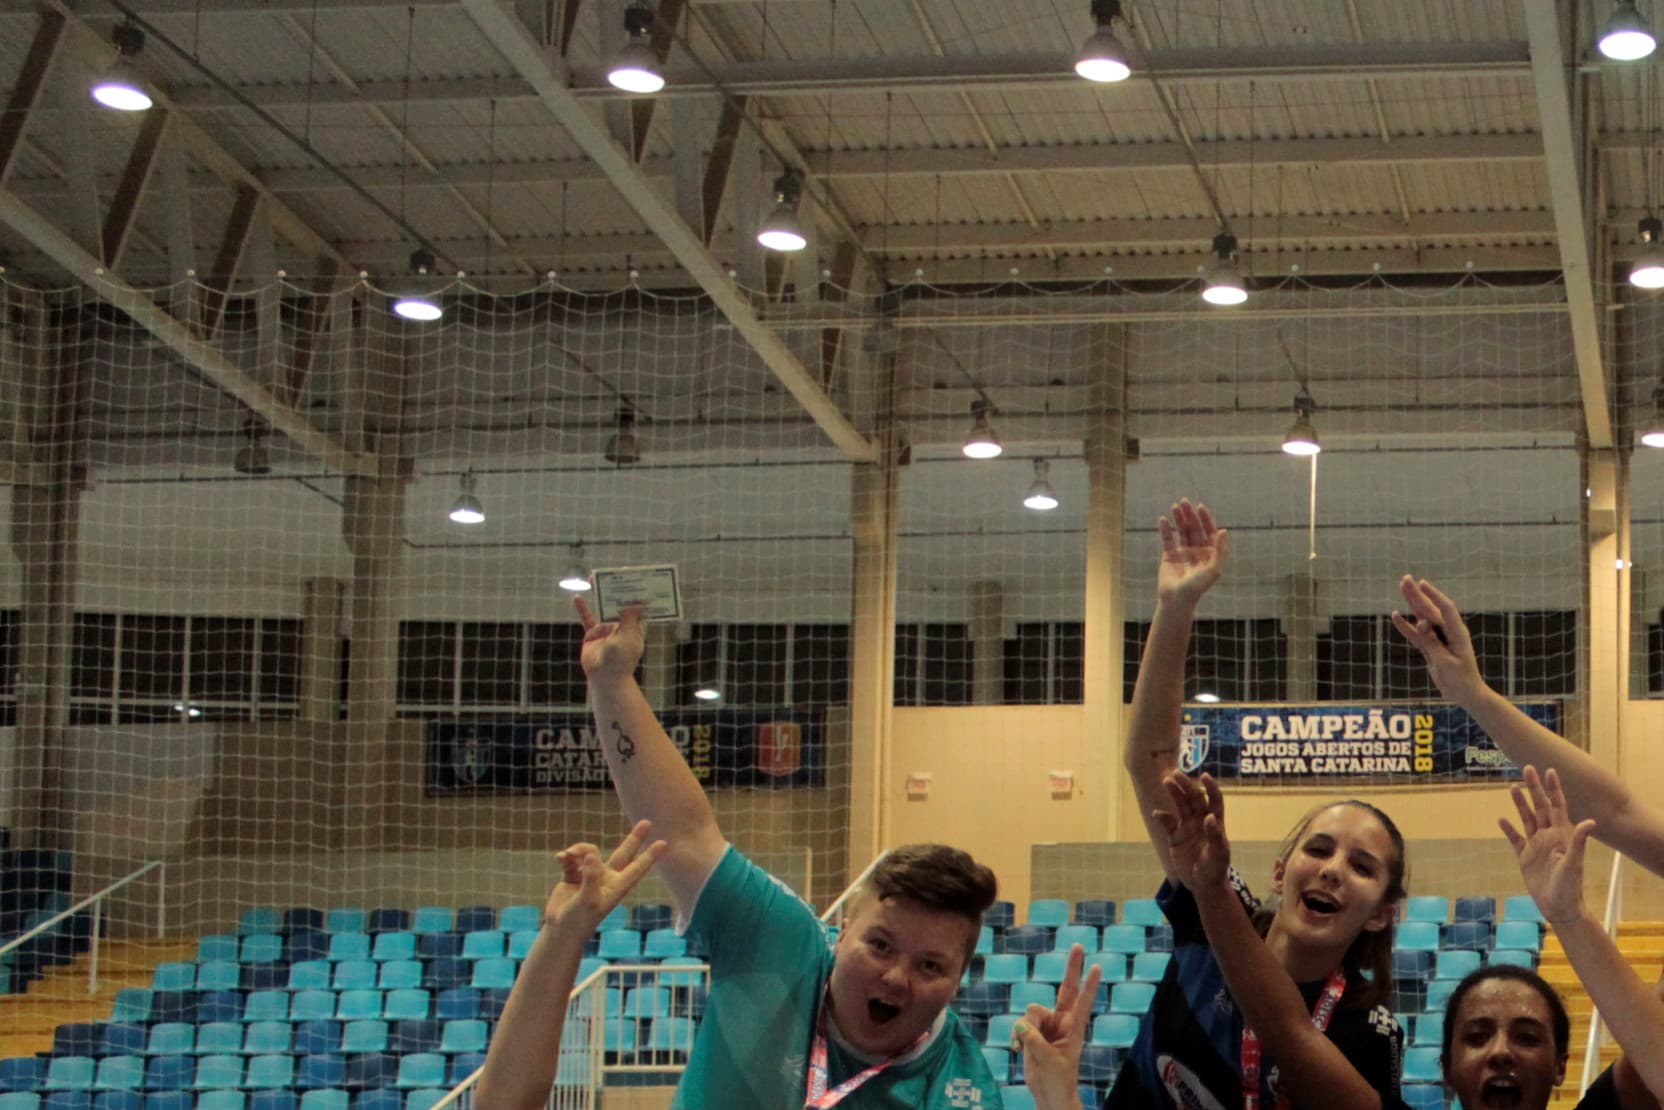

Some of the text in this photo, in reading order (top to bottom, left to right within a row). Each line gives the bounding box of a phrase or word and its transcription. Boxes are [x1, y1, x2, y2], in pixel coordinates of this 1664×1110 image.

[1240, 709, 1411, 740] CAMPEÃO
[1240, 743, 1412, 758] JOGOS ABERTOS DE
[1414, 715, 1434, 771] 2018
[1240, 758, 1411, 774] SANTA CATARINA
[1465, 746, 1510, 766] Fesp
